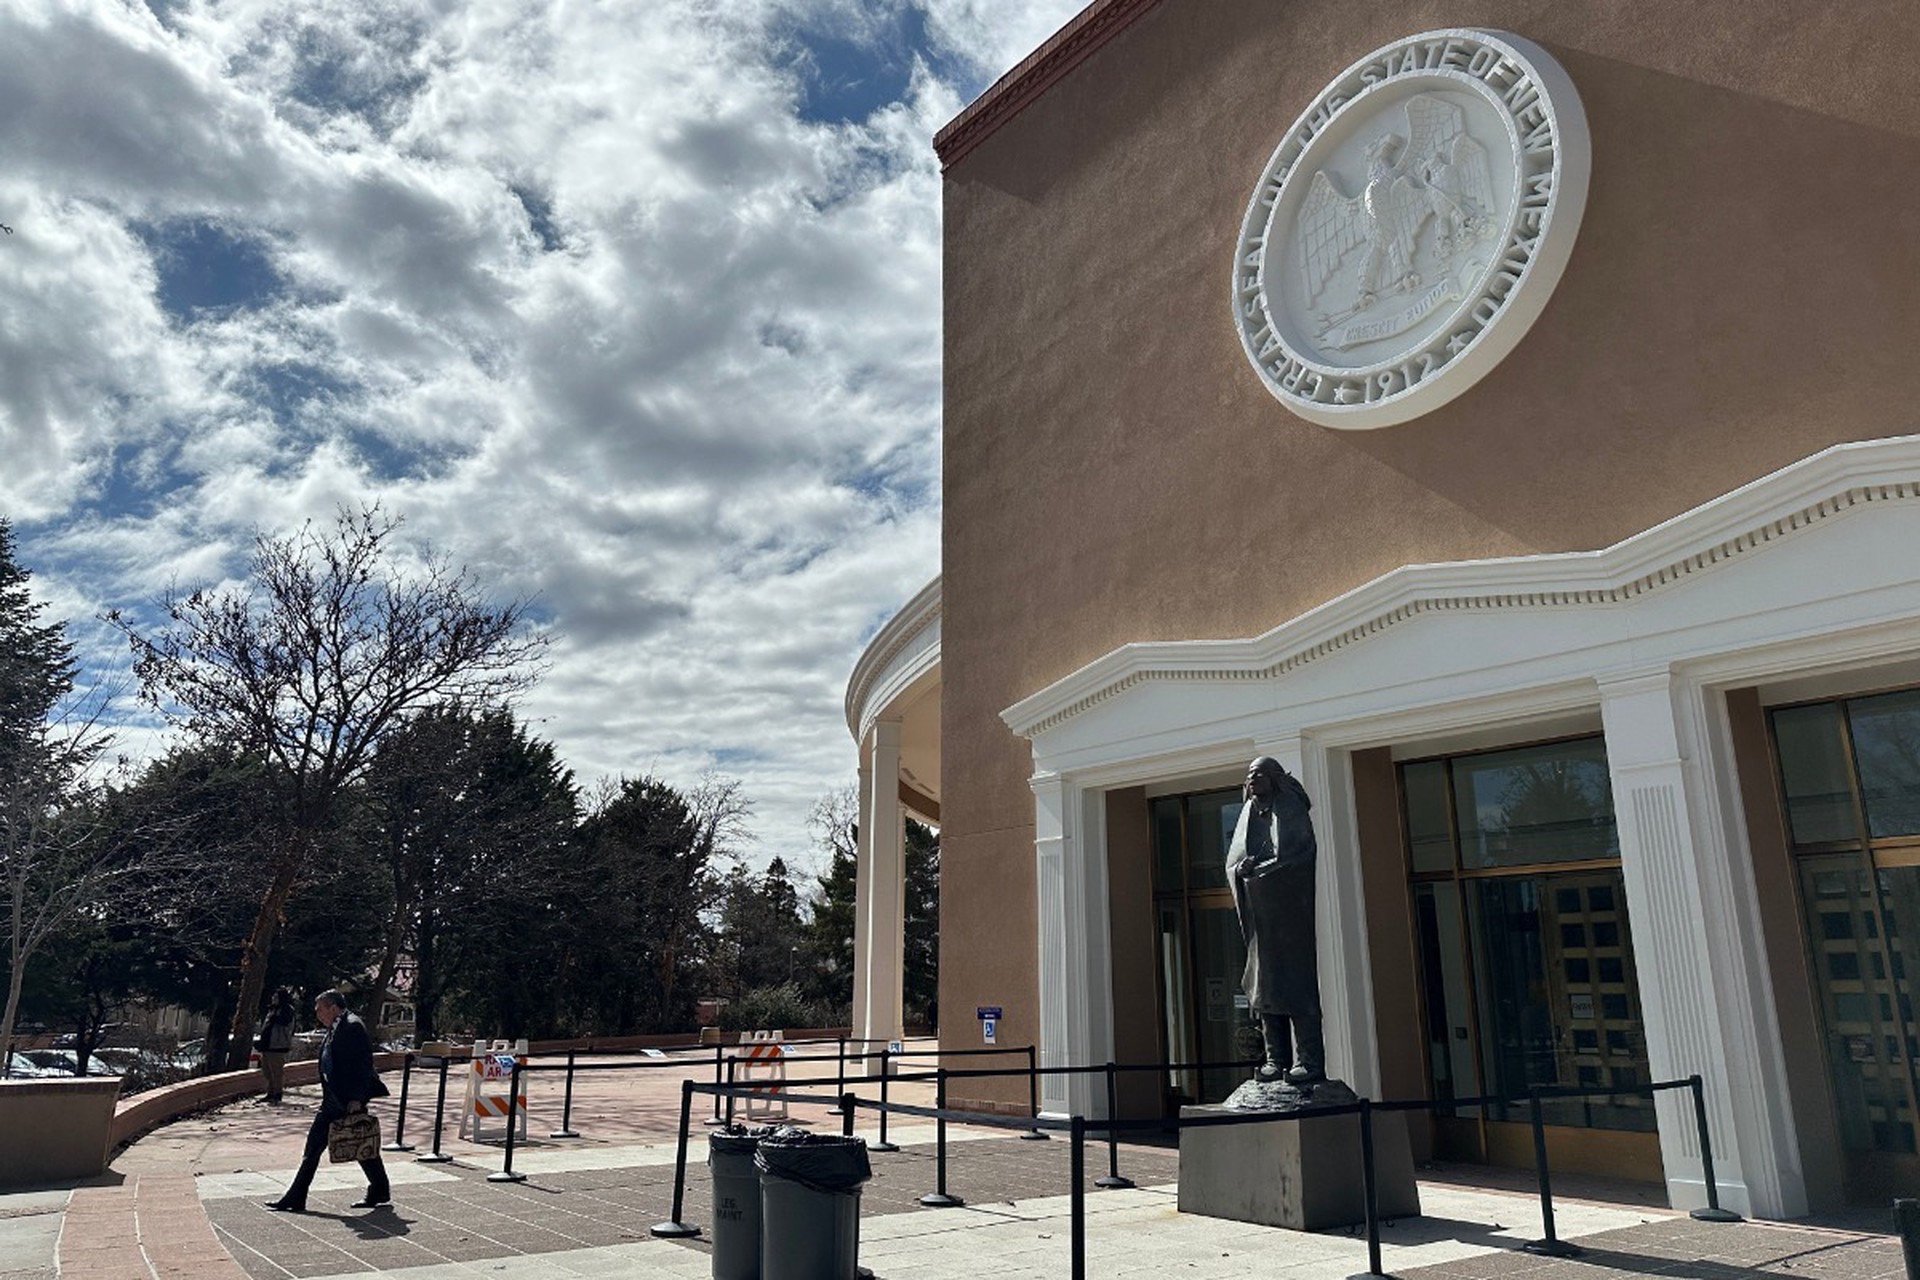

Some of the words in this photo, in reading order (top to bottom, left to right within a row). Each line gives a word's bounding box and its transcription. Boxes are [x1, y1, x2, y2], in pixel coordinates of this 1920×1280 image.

[1360, 39, 1465, 86] STATE
[1468, 45, 1517, 81] OF
[1503, 74, 1553, 153] NEW
[1471, 172, 1553, 326] MEXICO
[1248, 326, 1322, 400] GREAT
[1363, 352, 1434, 403] 1912
